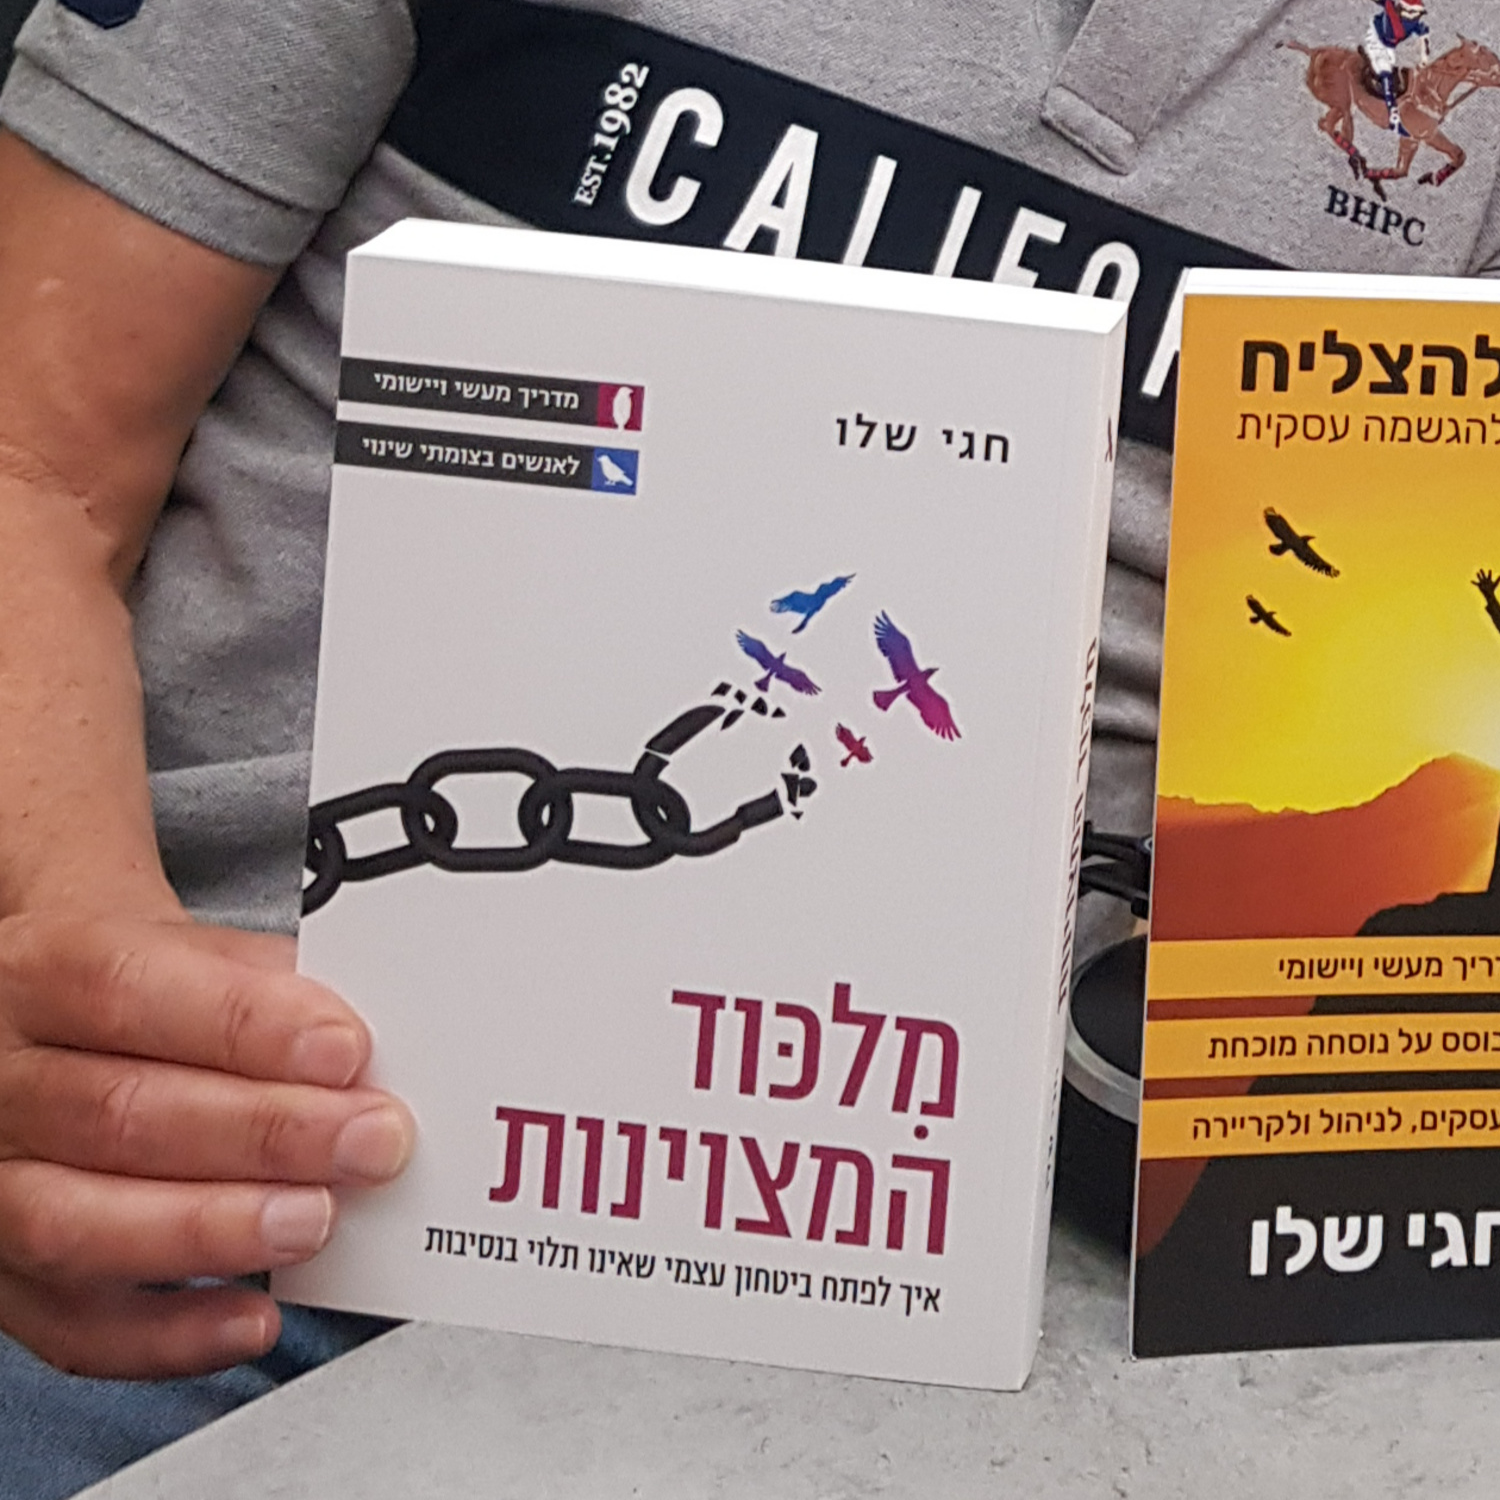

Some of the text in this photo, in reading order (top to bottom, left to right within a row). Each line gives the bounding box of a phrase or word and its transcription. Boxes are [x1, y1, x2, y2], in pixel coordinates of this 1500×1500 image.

[1324, 184, 1426, 248] BHPC
[374, 372, 580, 410] מדריך מעשי ויישומי
[835, 412, 1011, 464] חגי שלו
[1237, 410, 1350, 446] עסקית
[362, 437, 580, 477] לאנשים בצומתי שינוי
[1277, 957, 1363, 981] ויישומי
[1373, 956, 1443, 979] מעשי
[1207, 1034, 1297, 1060] מוכחת
[1306, 1032, 1389, 1056] נוסחה
[1398, 1028, 1432, 1055] על
[1192, 1110, 1310, 1143] ולקריירה
[1319, 1108, 1402, 1134] לניהול
[488, 1106, 951, 1255] המצוינות
[1249, 1205, 1384, 1277] שלו
[424, 1225, 941, 1316] איך לפתח ביטחון עצמי שאינו תלוי בנסיבות
